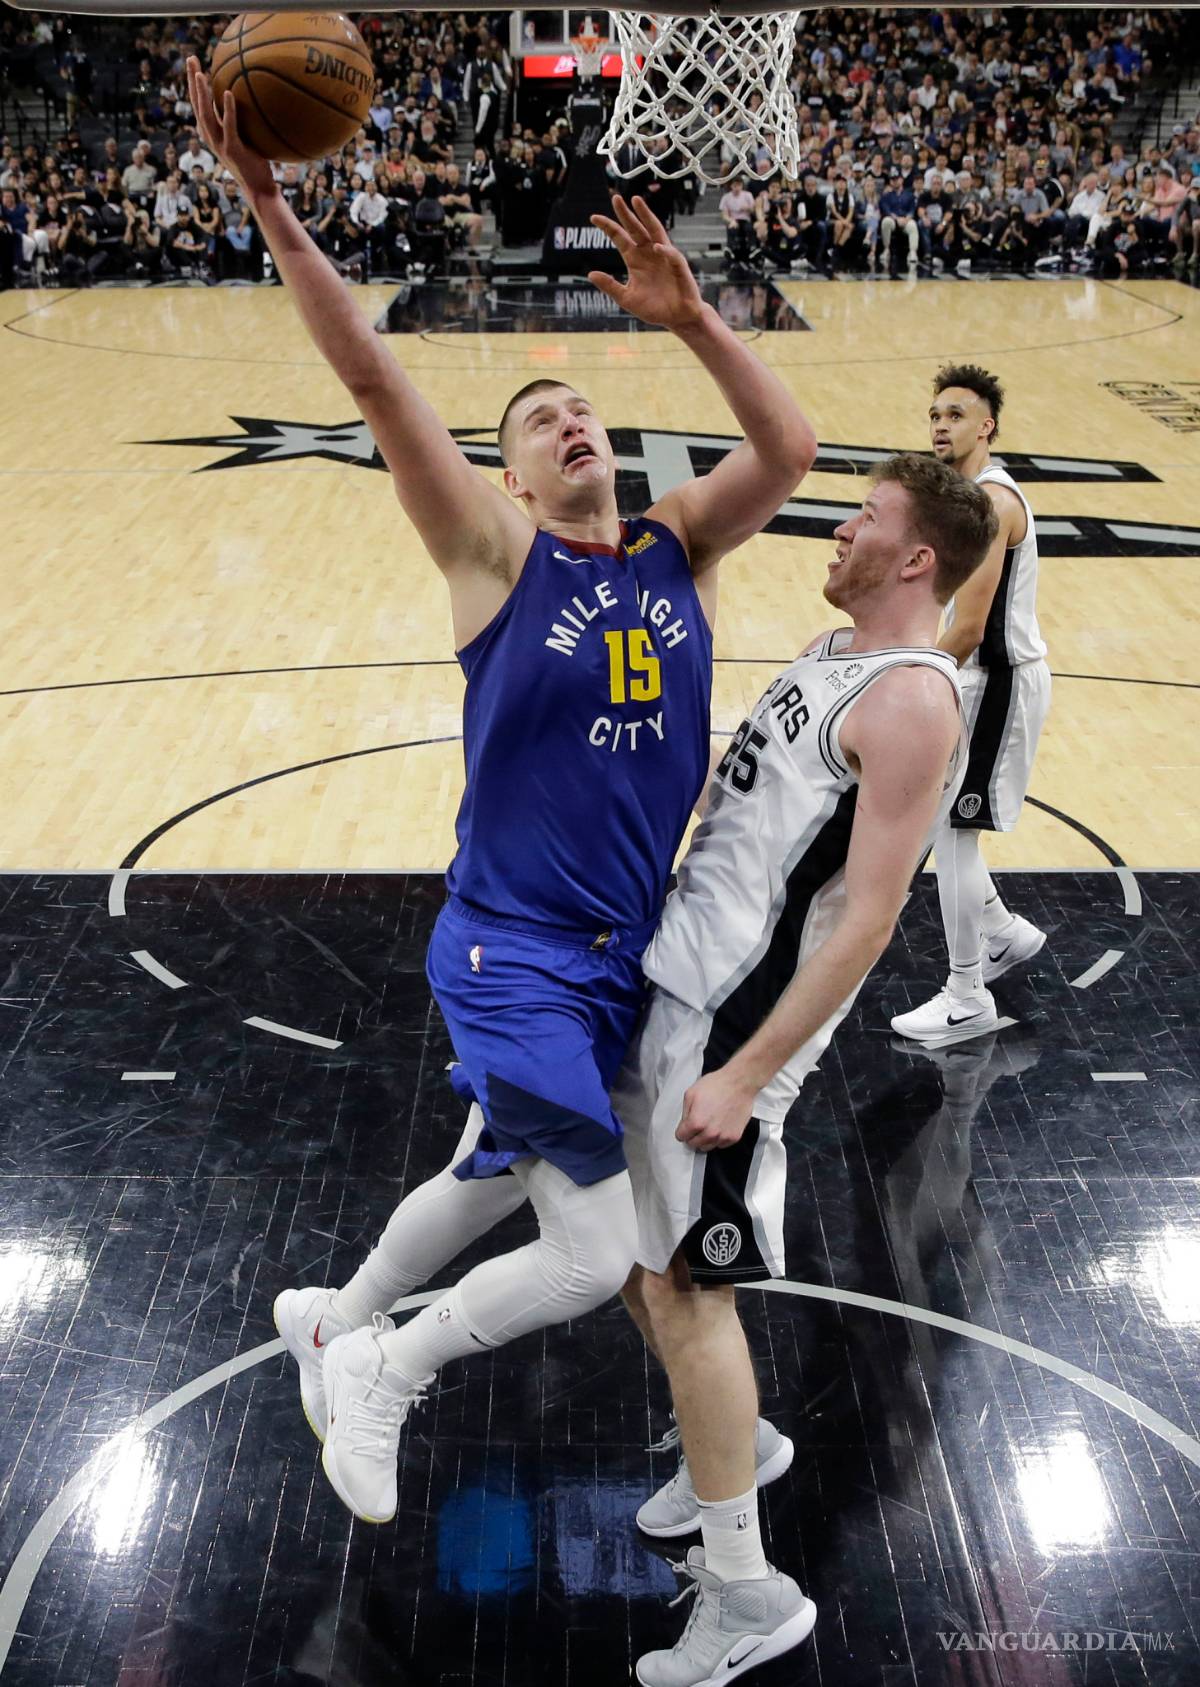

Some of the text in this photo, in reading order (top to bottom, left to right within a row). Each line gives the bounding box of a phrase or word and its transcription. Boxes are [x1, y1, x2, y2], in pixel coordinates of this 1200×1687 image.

[545, 580, 688, 656] MILE IGH
[604, 629, 661, 703] 15
[588, 711, 664, 752] CITY
[714, 718, 769, 794] 25
